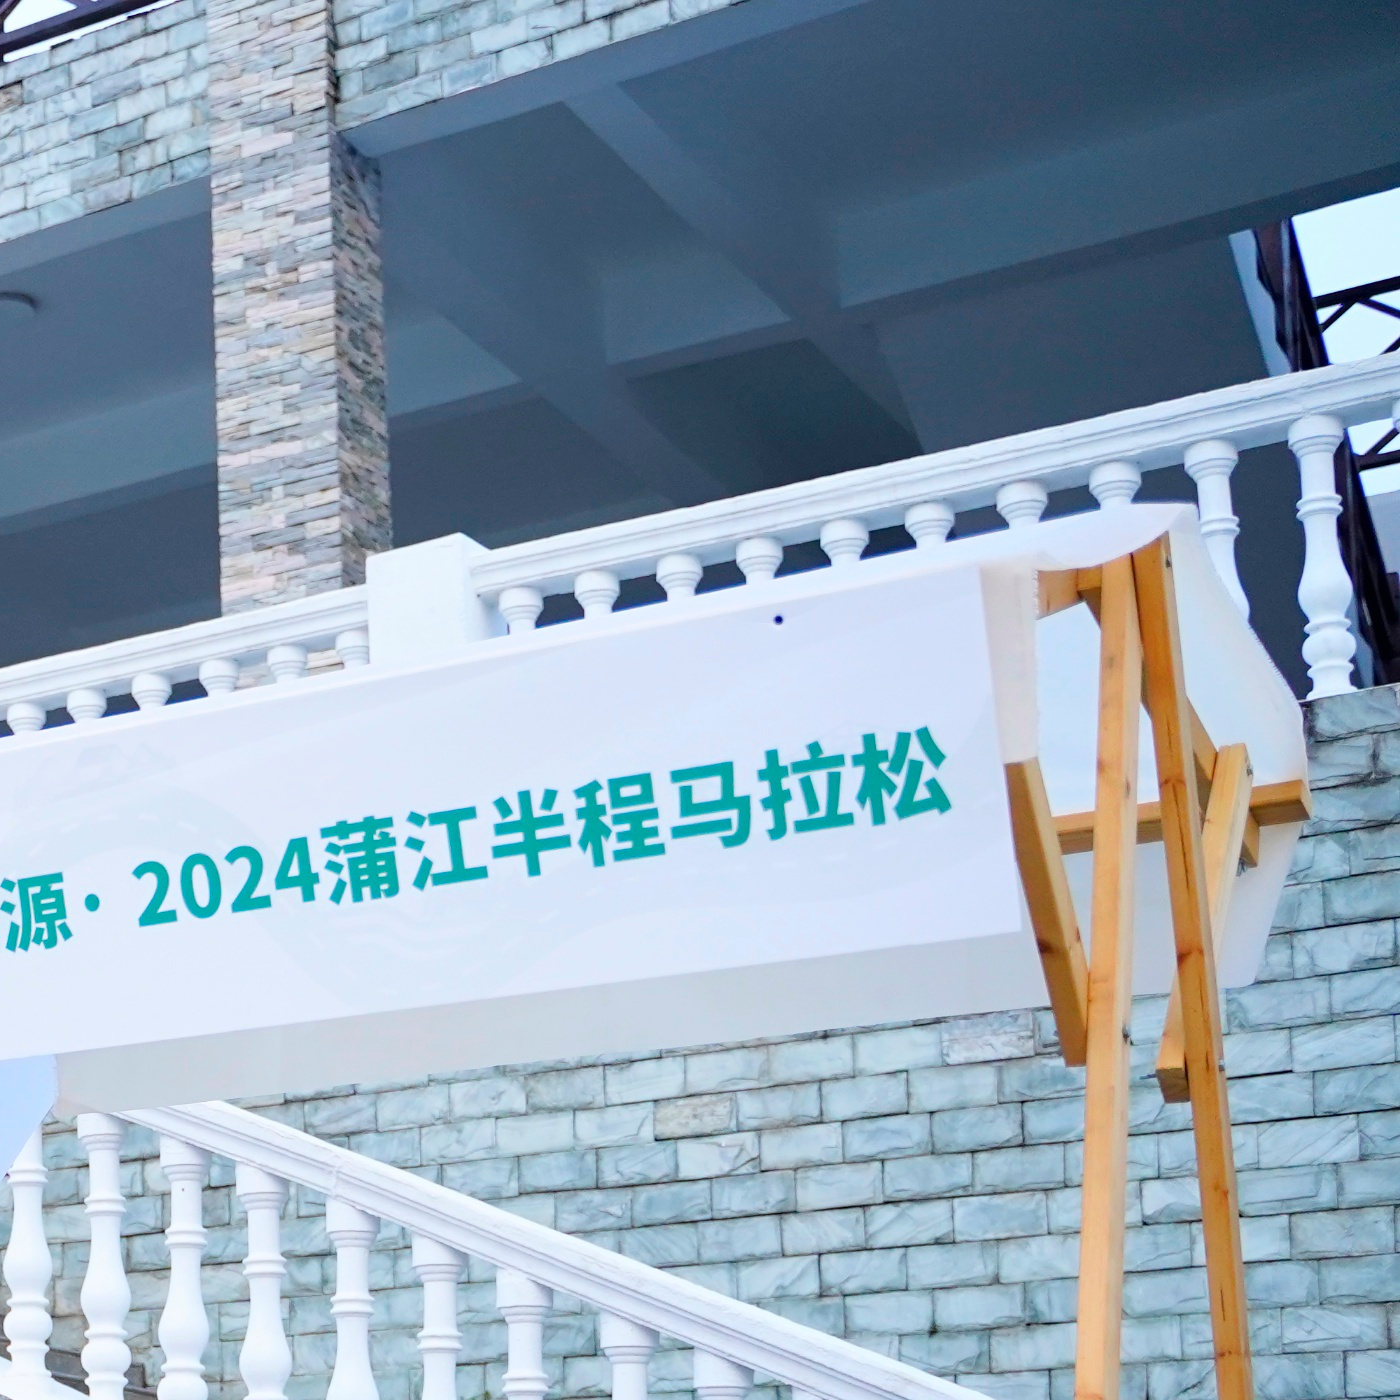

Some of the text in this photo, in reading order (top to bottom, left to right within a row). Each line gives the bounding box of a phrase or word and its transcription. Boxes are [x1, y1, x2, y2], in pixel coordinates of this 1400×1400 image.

[131, 725, 951, 927] 2024蒲江半程马拉松
